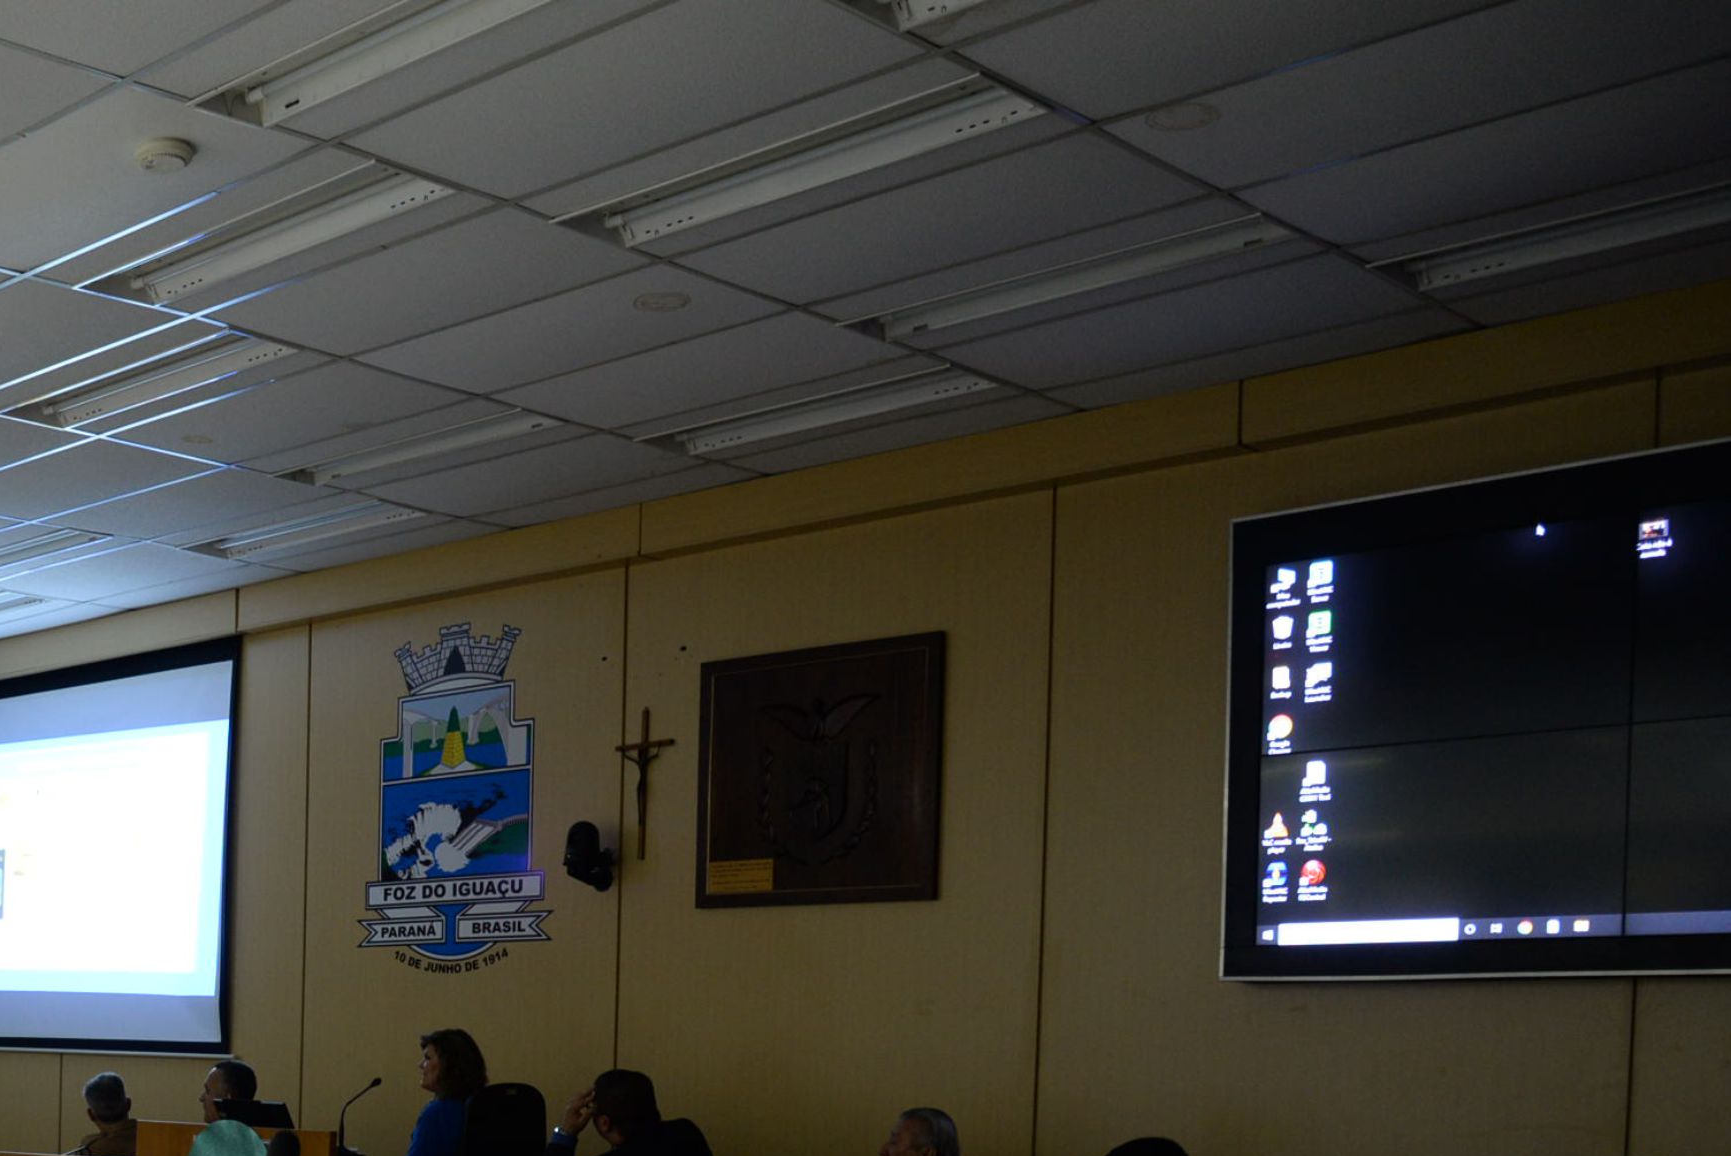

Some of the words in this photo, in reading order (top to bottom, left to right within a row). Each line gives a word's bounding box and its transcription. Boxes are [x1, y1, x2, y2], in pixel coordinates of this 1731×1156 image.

[383, 885, 417, 902] FOZ
[422, 884, 446, 898] DO
[452, 878, 524, 899] IGUAÇU
[380, 919, 436, 938] PARANÁ
[472, 920, 526, 934] BRASIL
[394, 950, 406, 962] 10
[408, 957, 420, 969] DE
[424, 964, 462, 974] JUNHO
[465, 960, 480, 972] DE
[482, 948, 510, 967] 1914
